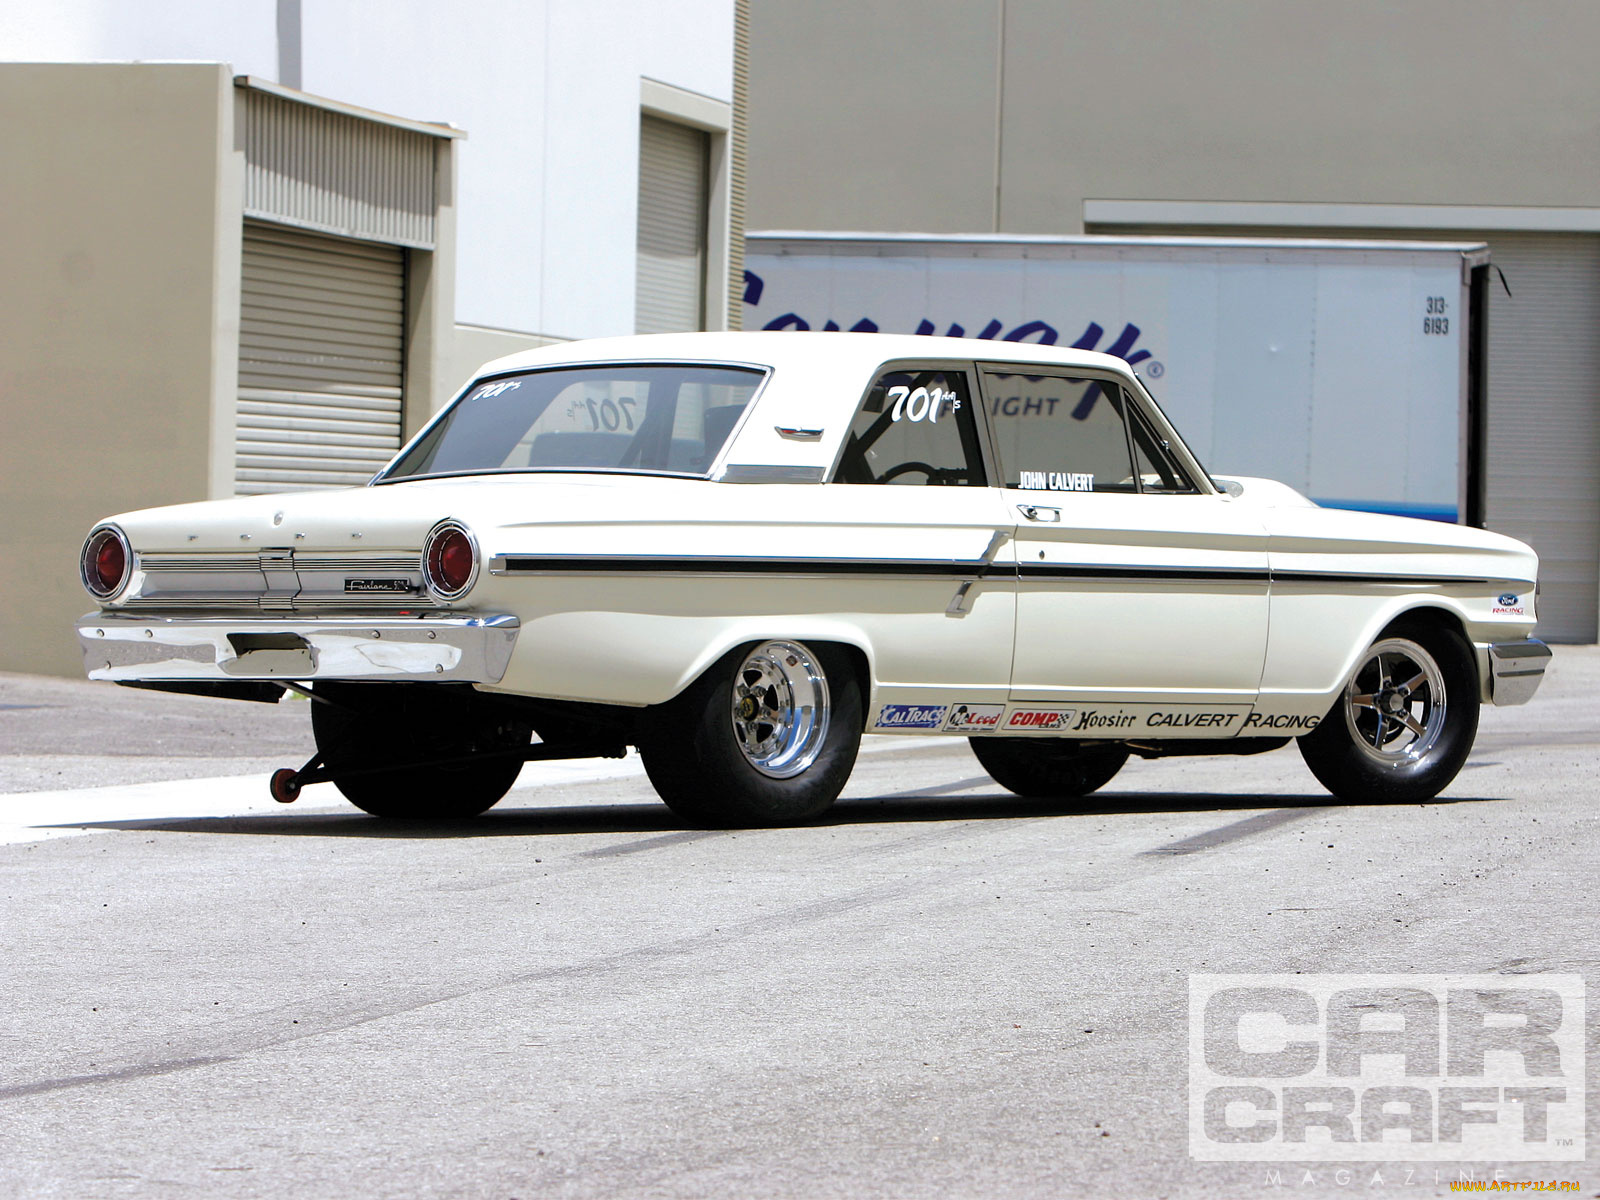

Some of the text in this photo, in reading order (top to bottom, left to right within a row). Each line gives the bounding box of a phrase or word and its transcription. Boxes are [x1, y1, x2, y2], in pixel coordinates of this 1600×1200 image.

[1424, 317, 1449, 335] 6193
[887, 386, 943, 424] 701
[1018, 471, 1094, 492] JOHN CALVERT
[1009, 711, 1059, 726] COMP
[1072, 710, 1137, 730] Hoosier
[1146, 713, 1321, 729] CALVERT RACING
